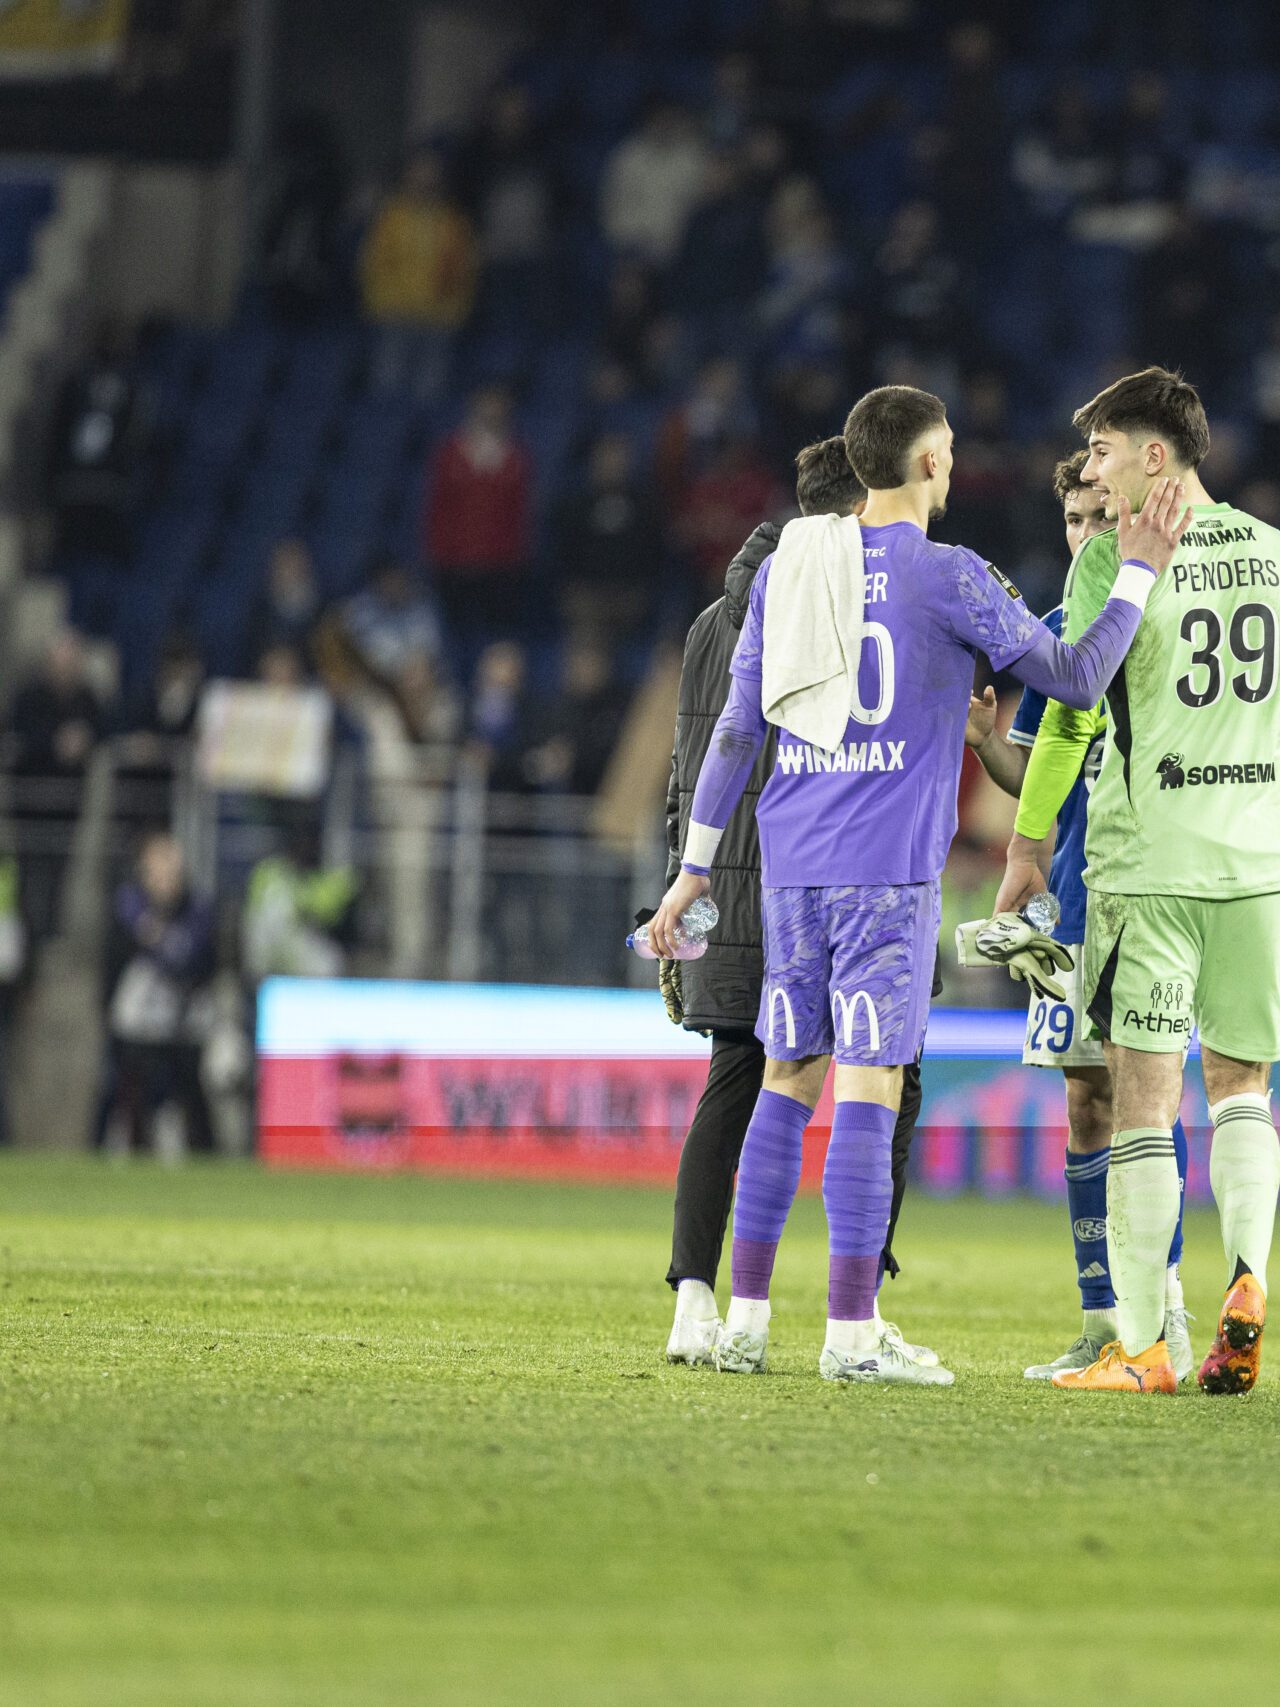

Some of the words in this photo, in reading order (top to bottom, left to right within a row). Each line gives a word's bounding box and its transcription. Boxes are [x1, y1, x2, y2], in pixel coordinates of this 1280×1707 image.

[1180, 527, 1257, 547] WINAMAX
[1172, 558, 1280, 593] PENDERS
[1176, 601, 1279, 708] 39
[777, 740, 906, 775] WINAMAX
[1031, 1001, 1075, 1054] 29
